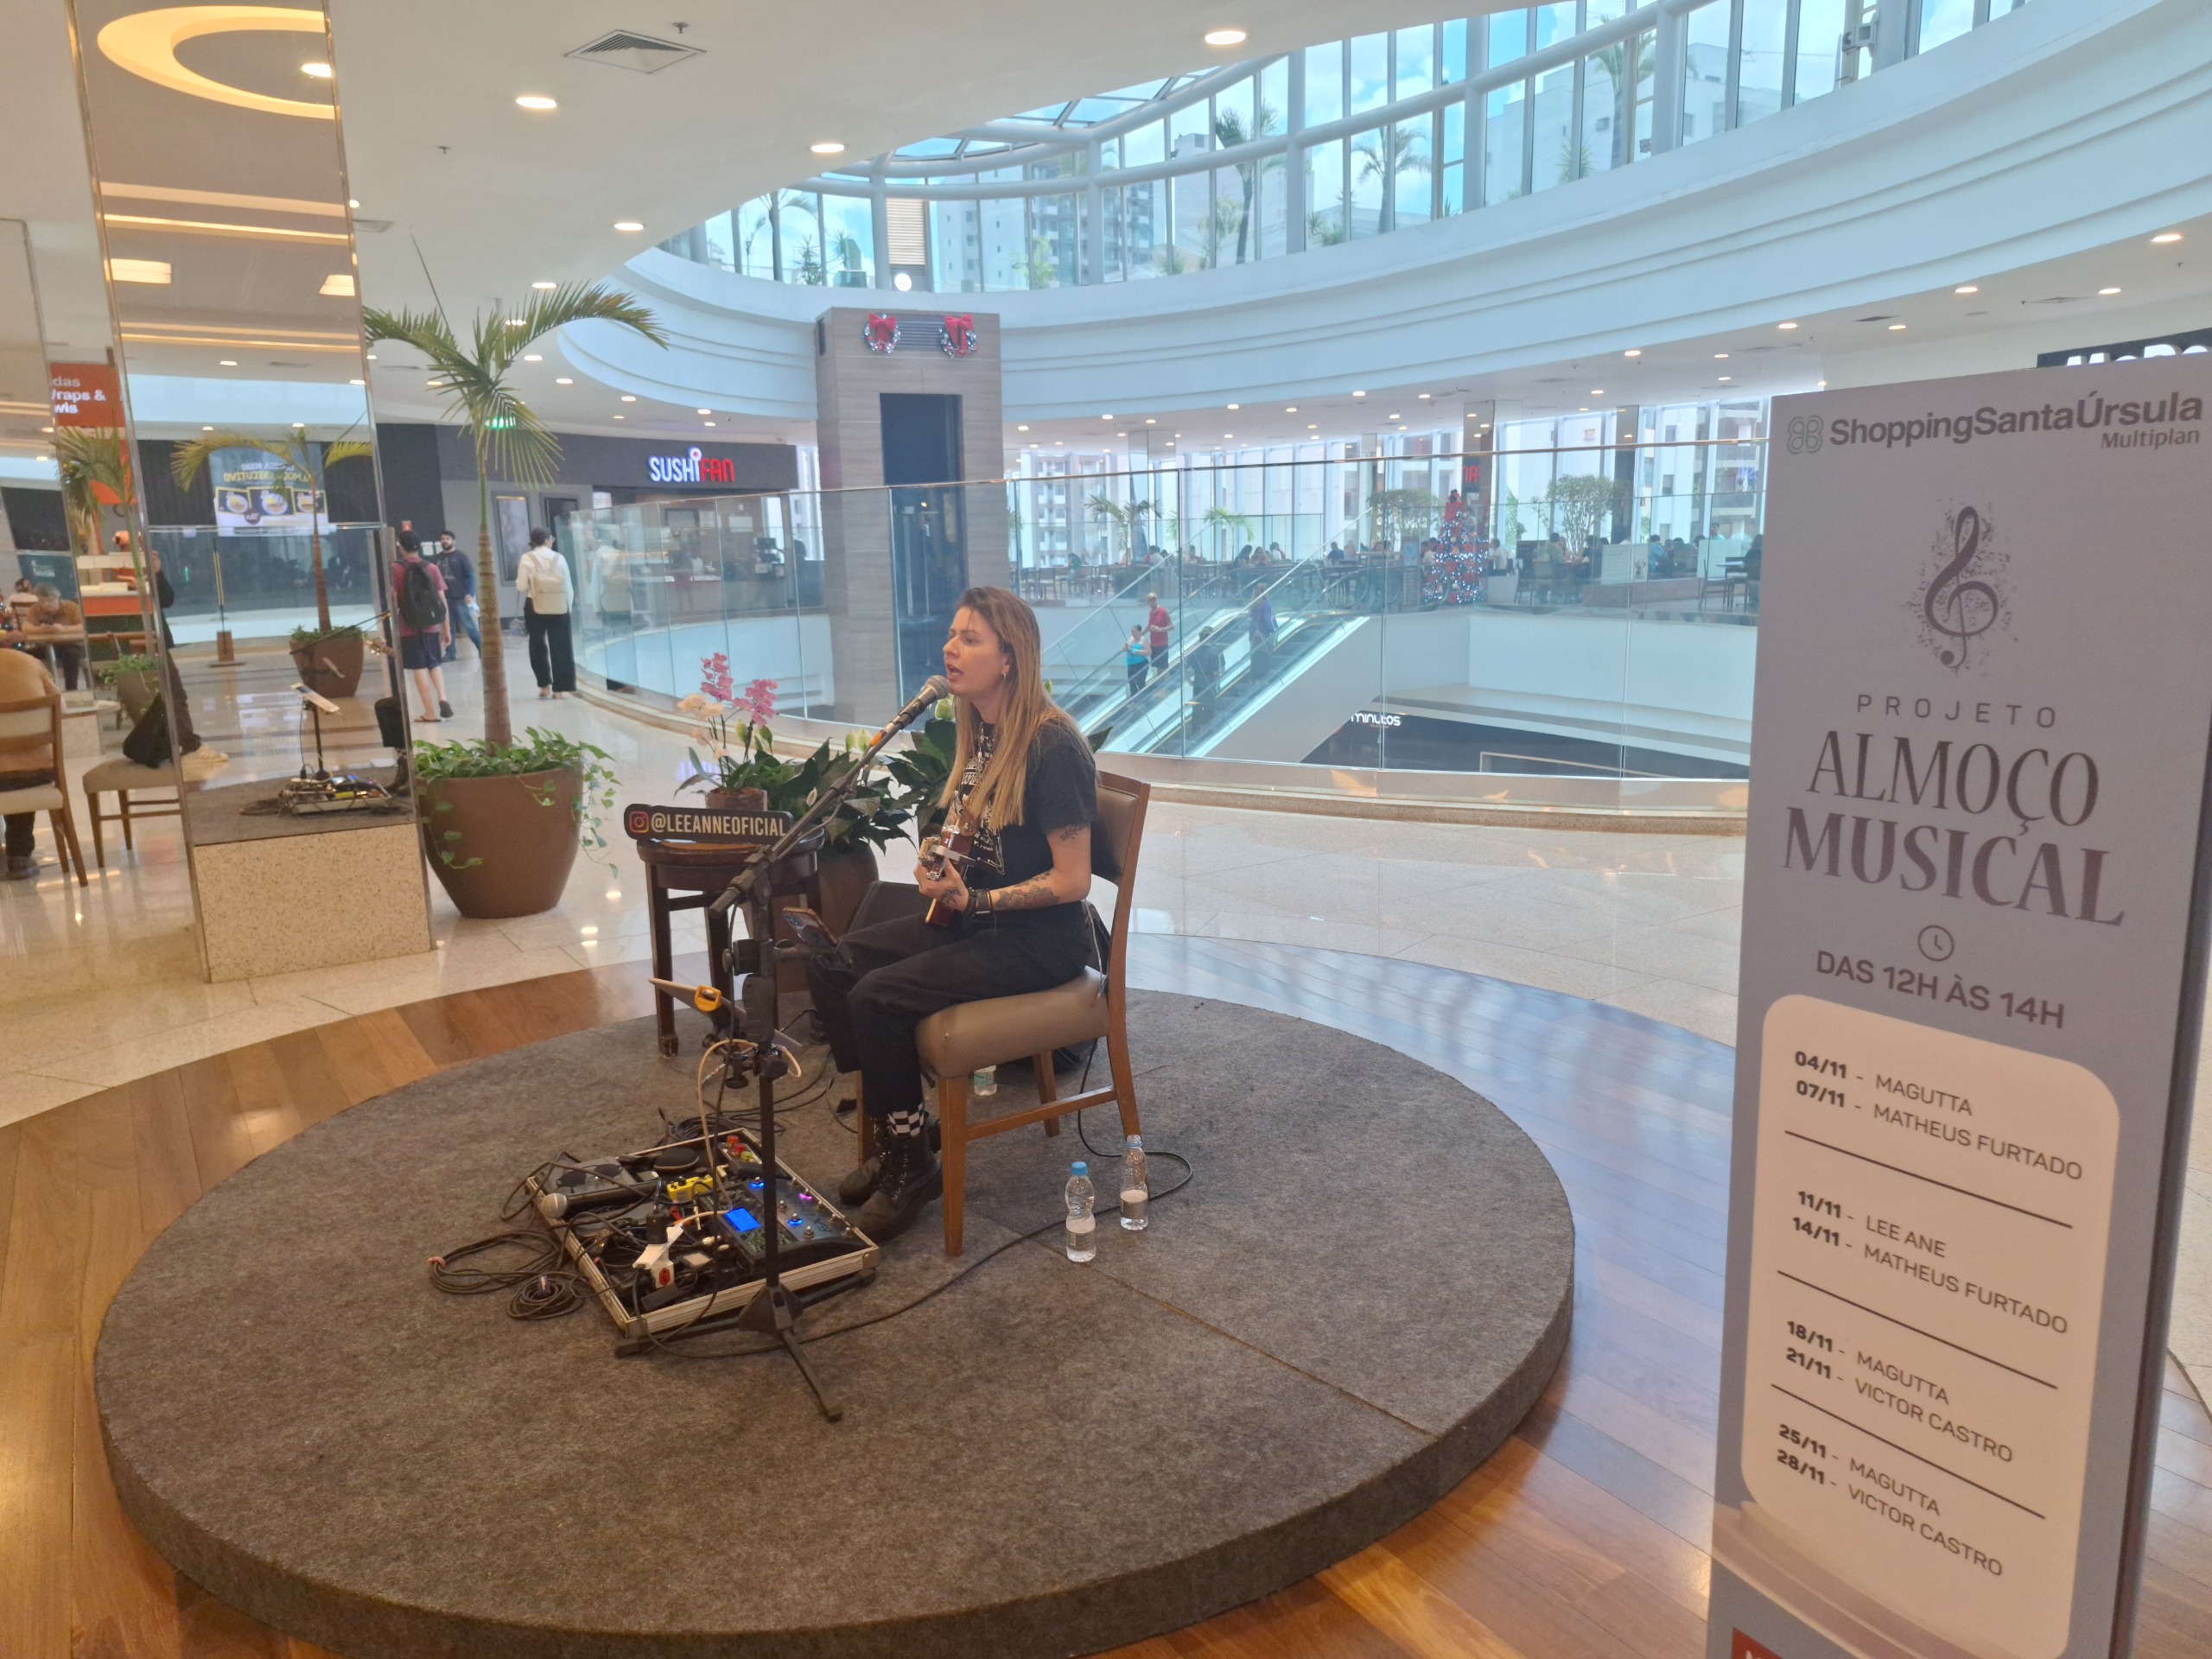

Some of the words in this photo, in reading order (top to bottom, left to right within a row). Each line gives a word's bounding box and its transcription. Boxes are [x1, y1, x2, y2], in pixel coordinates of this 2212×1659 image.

[94, 389, 106, 401] &
[1830, 391, 2203, 448] ShoppingSantaÚrsula
[2100, 428, 2200, 450] Multiplan
[1858, 694, 2056, 729] PROJETO
[1806, 730, 2100, 836] ALMOÇO
[651, 812, 787, 836] @LEEANNEOFICIAL
[1783, 806, 2125, 927] MUSICAL
[1816, 950, 1875, 984] DAS
[1883, 967, 1938, 1000] 12H
[1945, 975, 1990, 1012] ÀS
[2000, 993, 2065, 1029] 14H
[1795, 1051, 1847, 1079] 04/11
[1876, 1074, 1973, 1116] MAGUTTA
[1796, 1080, 1846, 1108] 07/11
[1874, 1103, 1972, 1147] MATHEUS
[1977, 1135, 2083, 1180] FURTADO
[1797, 1191, 1841, 1218] 11/11
[1866, 1216, 1901, 1241] LEE
[1904, 1231, 1947, 1258] ANE
[1793, 1217, 1840, 1247] 14/11
[1865, 1244, 1960, 1293] MATHEUS
[1965, 1282, 2068, 1334] FURTADO
[1787, 1321, 1833, 1352] 18/11
[1857, 1351, 1949, 1405] MAGUTTA
[1786, 1347, 1831, 1379] 21/11
[1855, 1378, 1923, 1423] VICTOR
[1929, 1413, 2013, 1462] CASTRO
[1779, 1424, 1826, 1459] 25/11
[1850, 1458, 1941, 1516] MAGUTTA
[1777, 1449, 1825, 1484] 28/11
[1848, 1484, 1916, 1532] VICTOR
[1920, 1523, 2003, 1577] CASTRO
